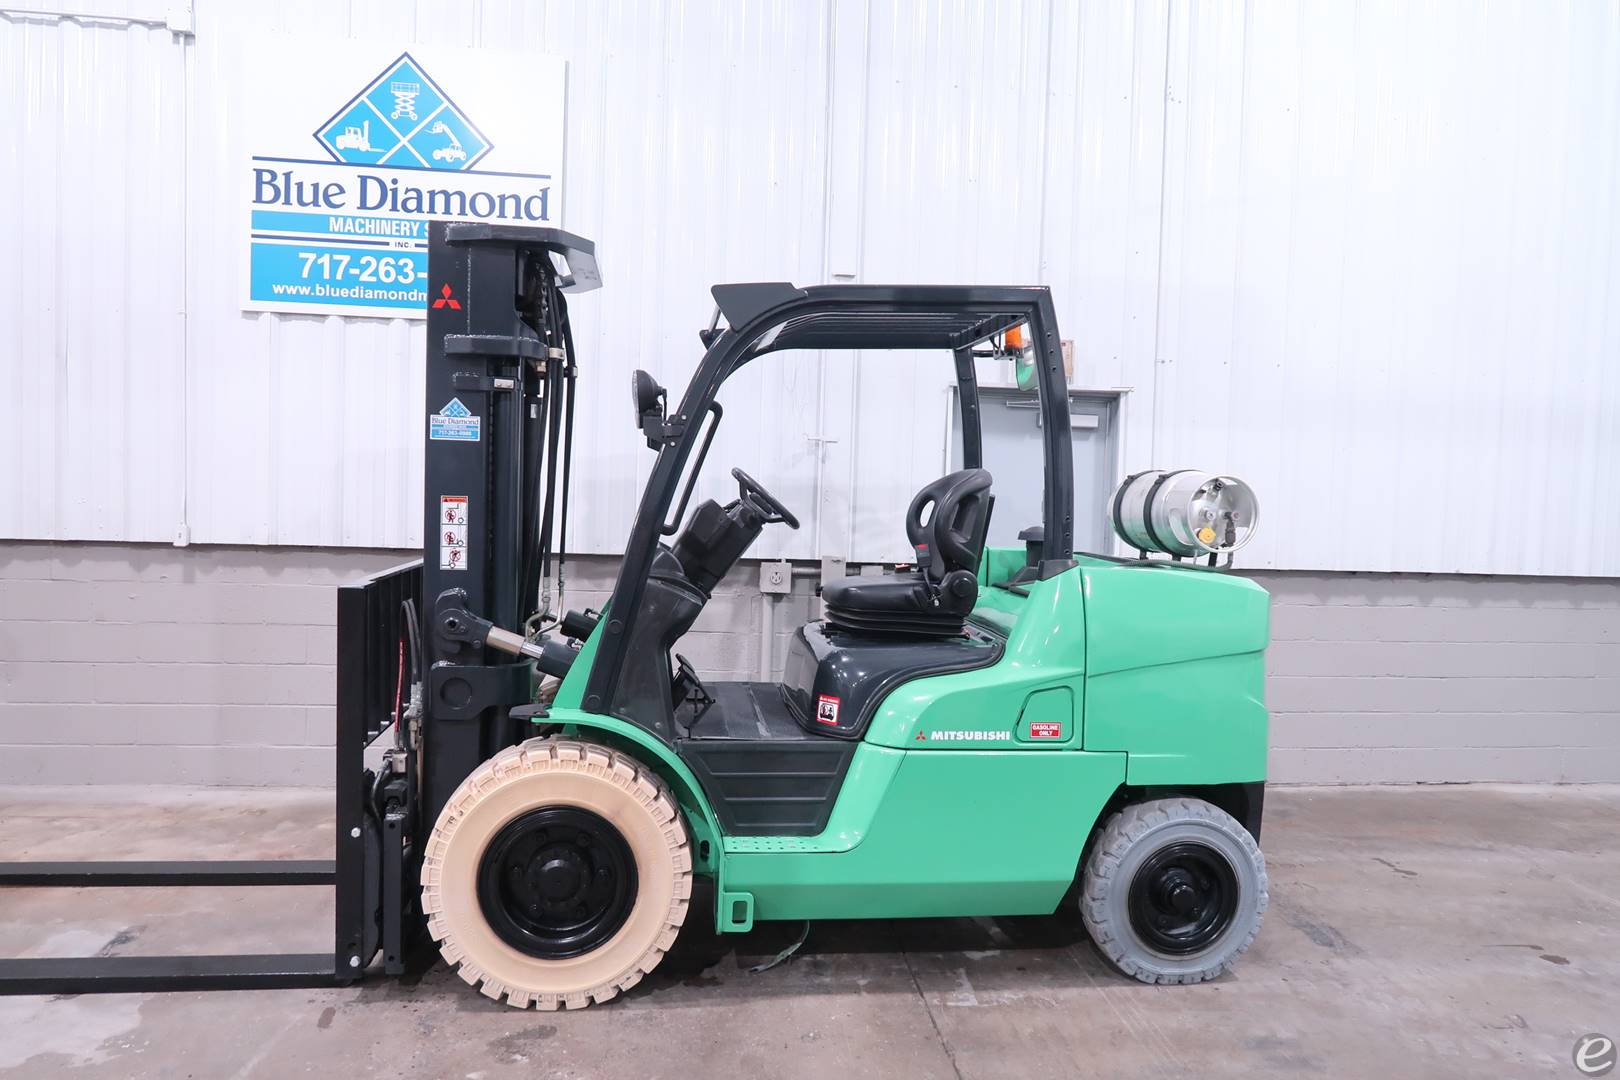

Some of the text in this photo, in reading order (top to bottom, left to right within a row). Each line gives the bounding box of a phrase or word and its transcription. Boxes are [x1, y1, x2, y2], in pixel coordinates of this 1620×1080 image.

[252, 168, 551, 221] Blue Diamond
[329, 216, 420, 237] MACHINERY
[394, 241, 412, 249] INC.
[931, 731, 1010, 740] MITSUBISHI
